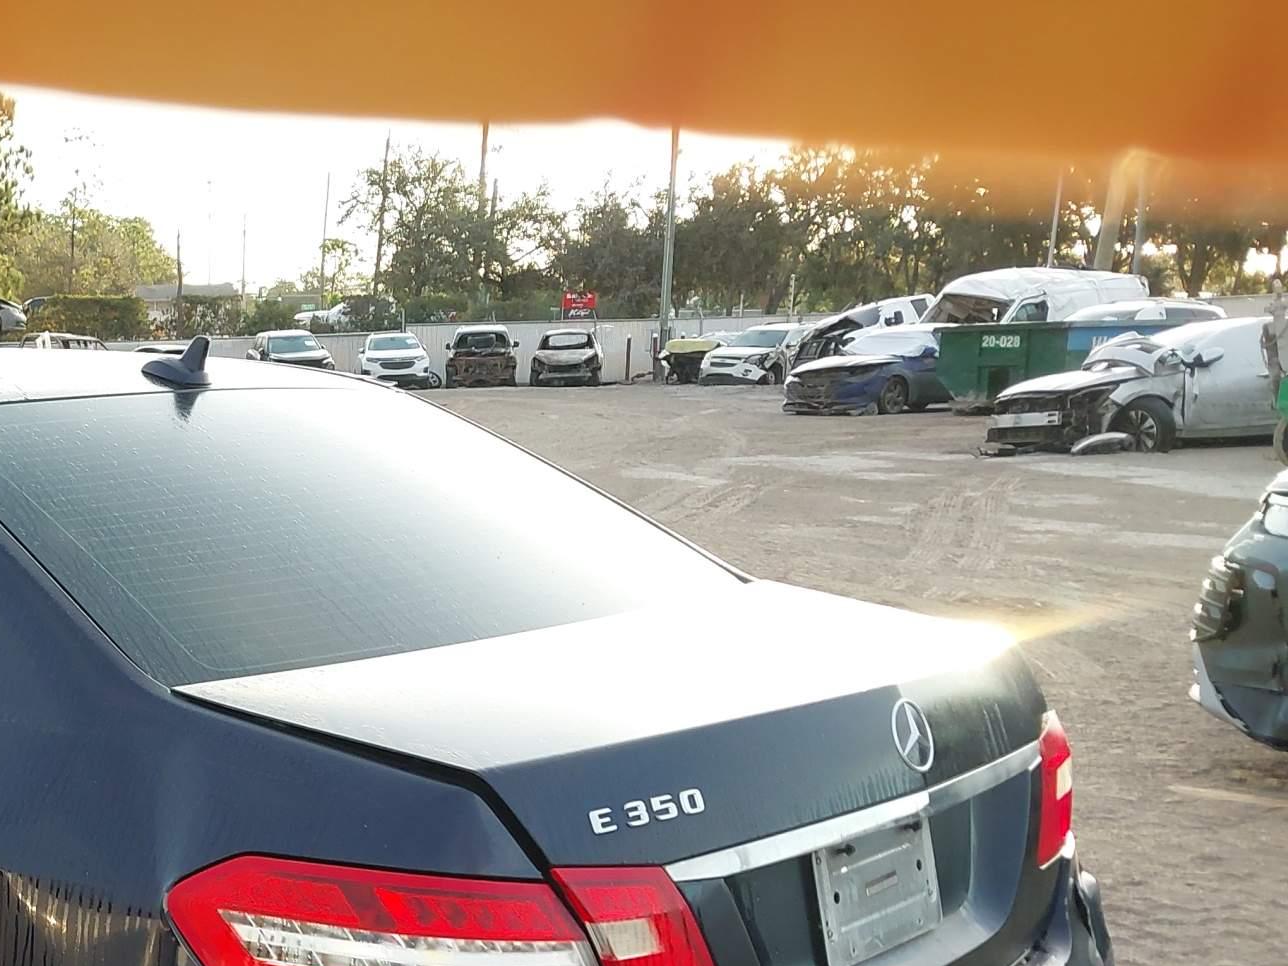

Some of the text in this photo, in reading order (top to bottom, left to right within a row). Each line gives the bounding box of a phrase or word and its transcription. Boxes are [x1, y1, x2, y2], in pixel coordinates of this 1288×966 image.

[982, 335, 1021, 348] 20-028
[588, 788, 705, 835] E 350
